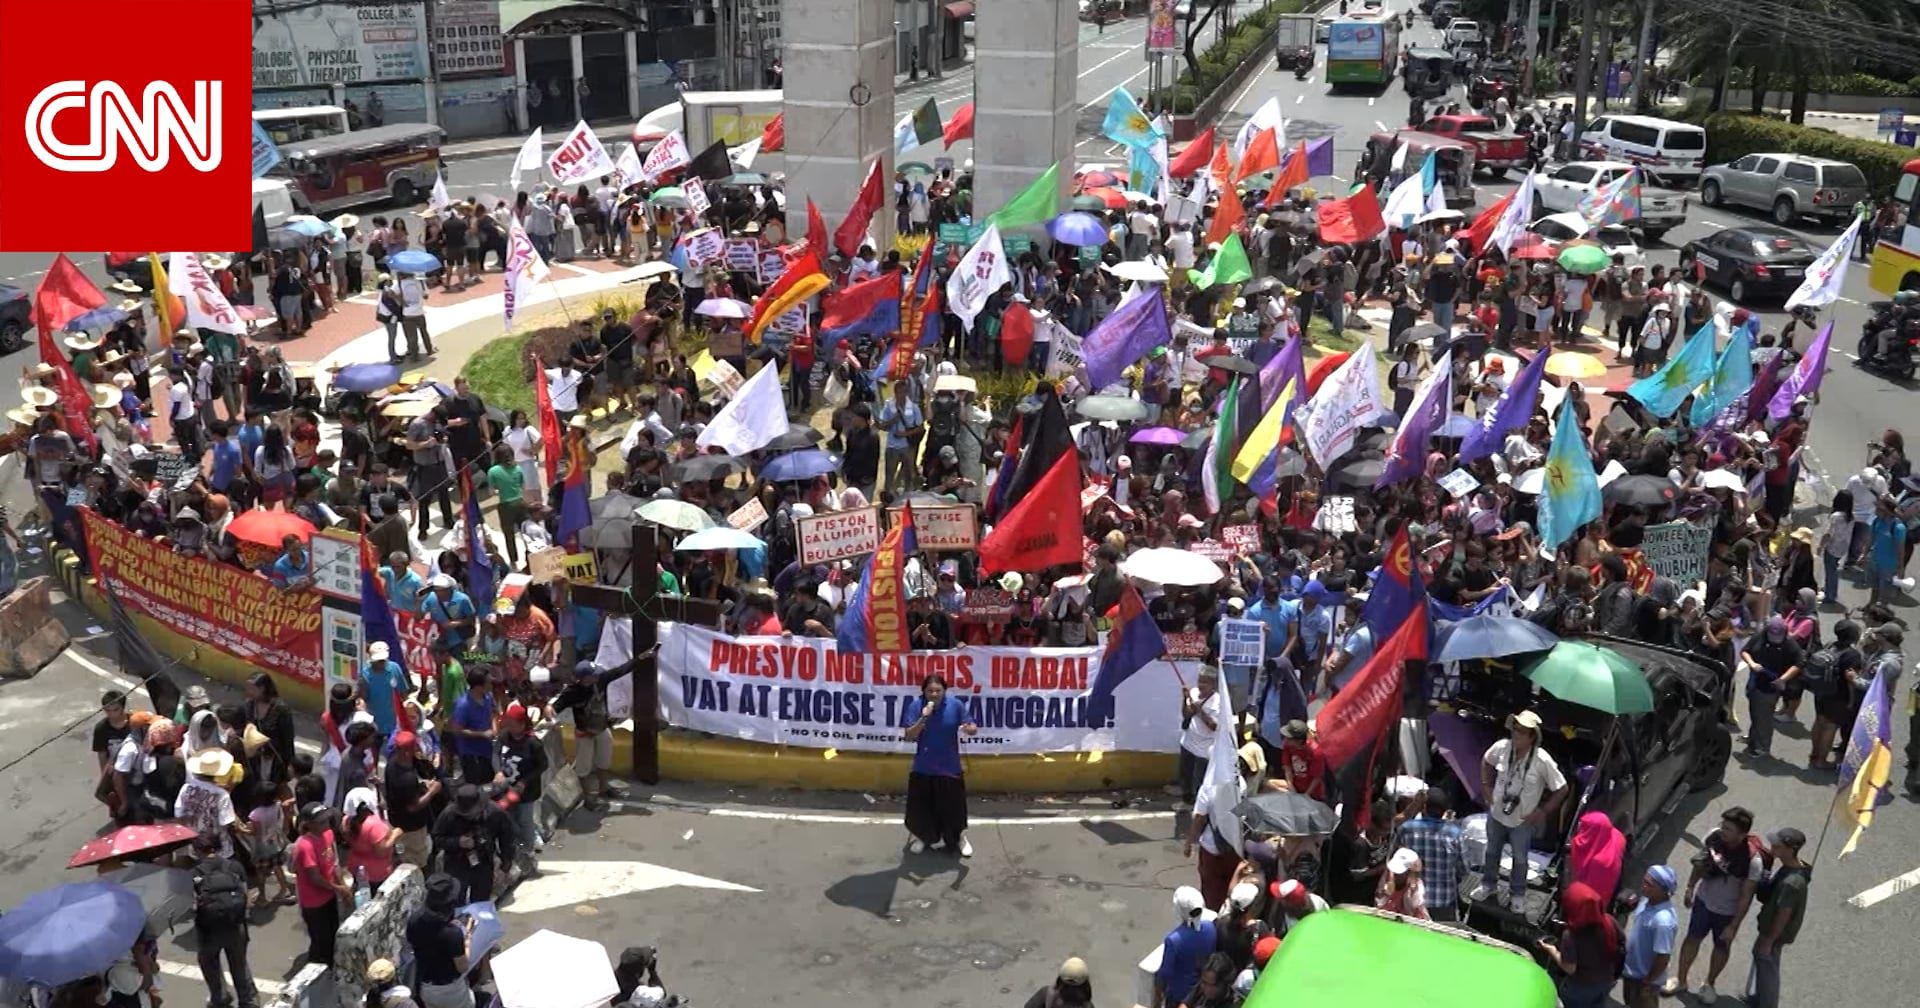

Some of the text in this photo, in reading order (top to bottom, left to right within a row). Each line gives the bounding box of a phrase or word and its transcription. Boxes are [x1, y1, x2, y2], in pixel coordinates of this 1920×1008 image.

[308, 50, 359, 66] PHYSICAL
[310, 66, 362, 82] THERAPIST
[815, 514, 867, 532] PISTON
[804, 525, 874, 544] CALUMPIT
[807, 541, 876, 562] BULACAN
[567, 562, 595, 580] VAT
[872, 549, 900, 651] PISTON
[213, 601, 282, 642] KULTURA!
[710, 639, 1088, 694] PRESYO NG LANGIS, IBABA!
[681, 676, 729, 710] VAT
[733, 685, 770, 719] AT
[778, 686, 875, 726] EXCISE
[791, 729, 809, 737] NO
[813, 730, 830, 738] TO
[832, 731, 854, 740] OIL
[856, 733, 897, 742] PRICE
